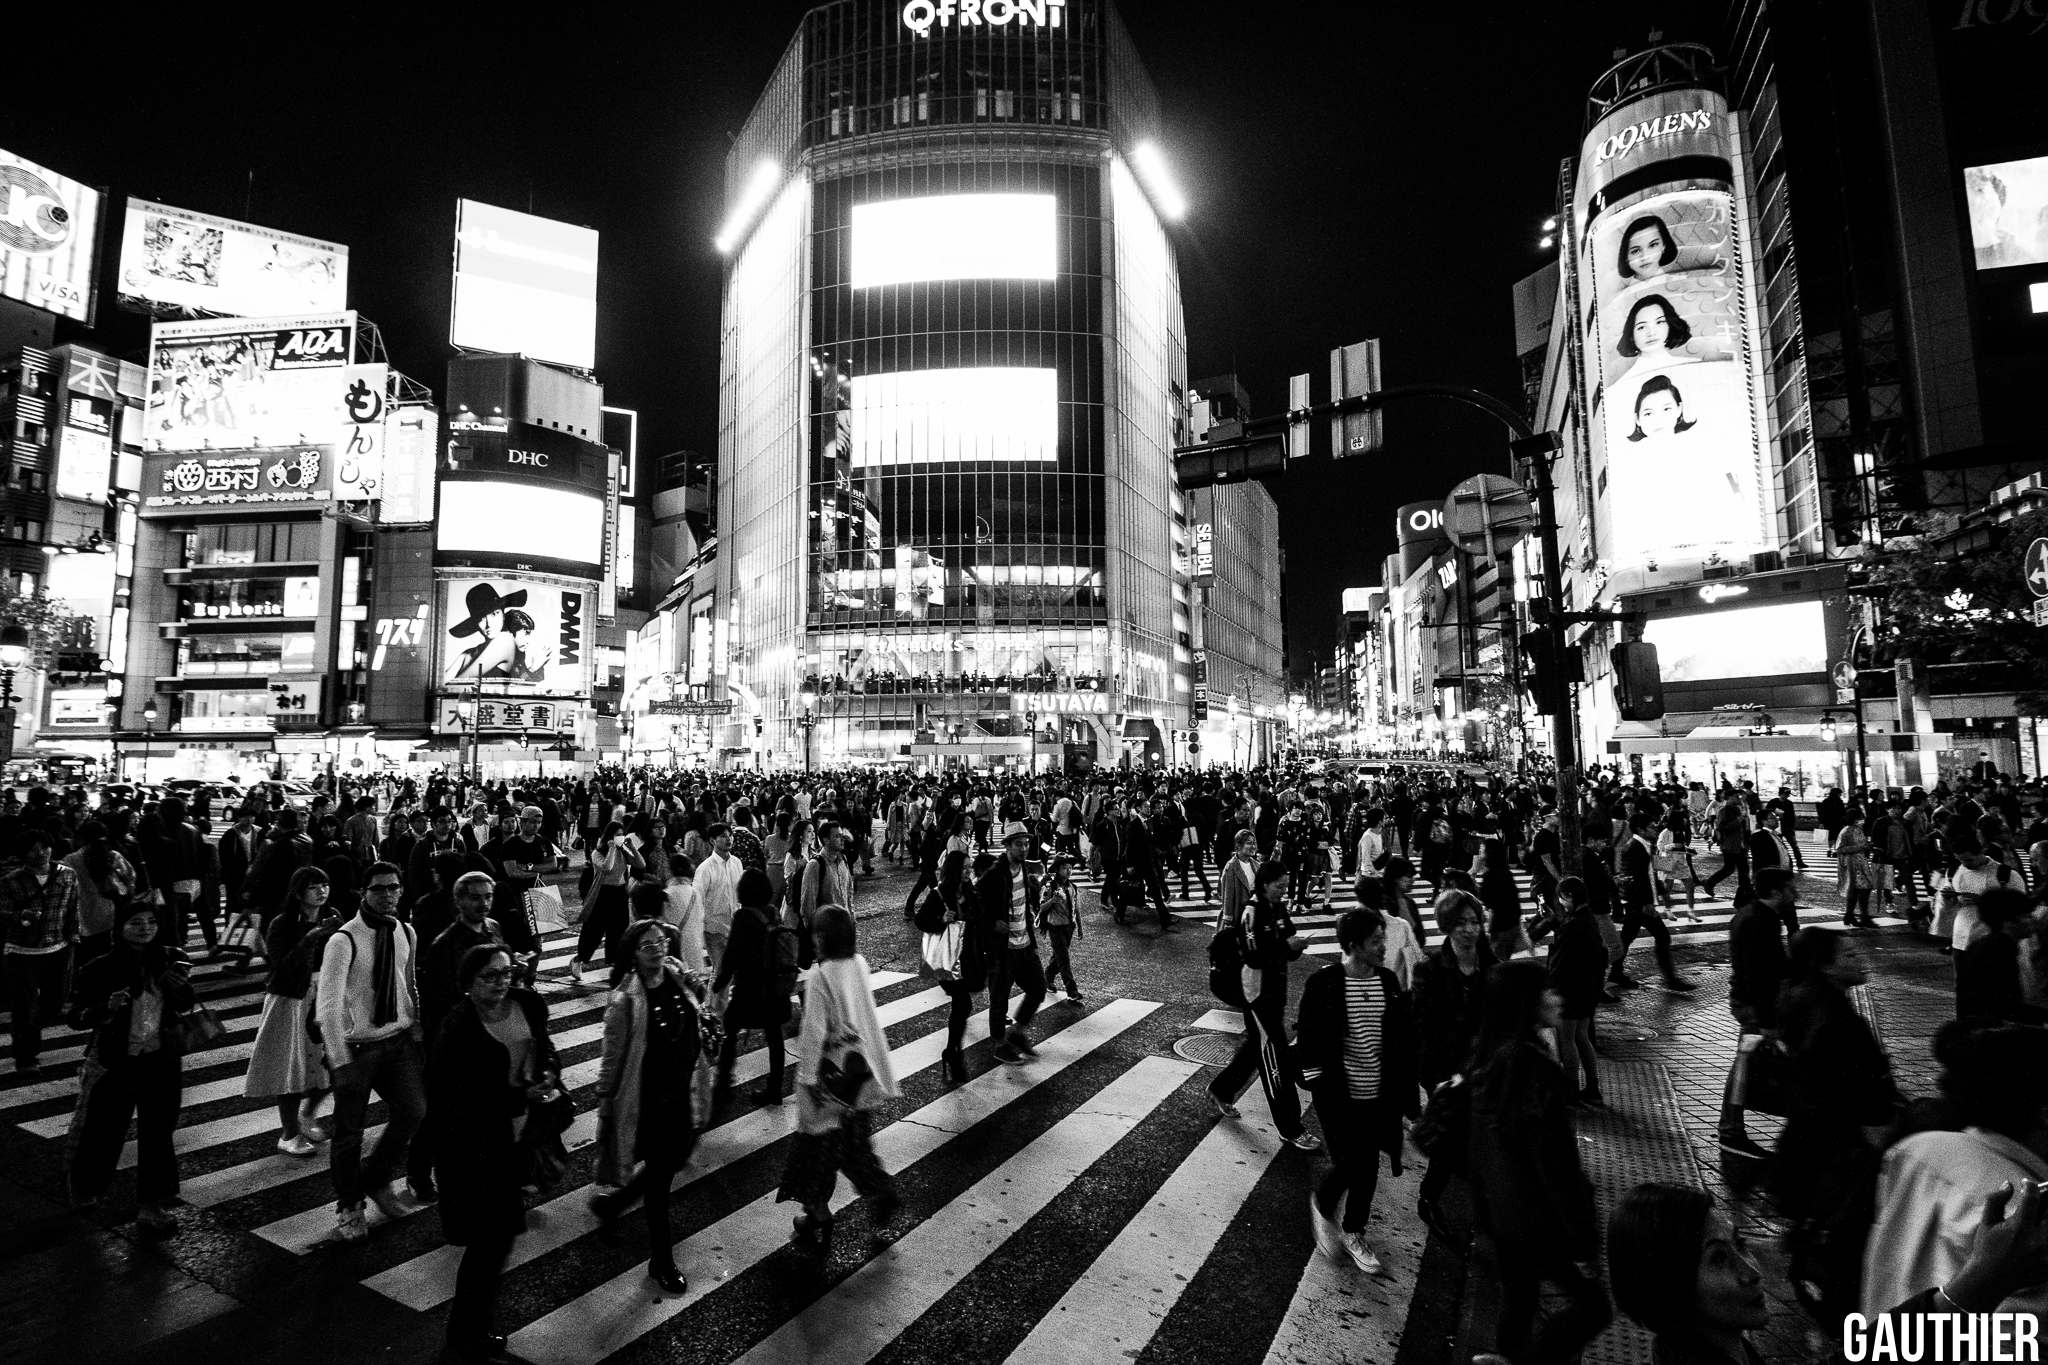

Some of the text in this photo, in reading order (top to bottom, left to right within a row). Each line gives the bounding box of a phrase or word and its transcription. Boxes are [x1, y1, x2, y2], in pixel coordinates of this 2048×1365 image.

[903, 0, 1065, 37] QFRONT
[39, 281, 81, 304] VISA
[278, 329, 346, 356] AOA
[508, 449, 549, 468] DHC
[205, 467, 261, 491] 西村
[559, 591, 582, 666] DMM
[1013, 693, 1108, 713] TSUTAYA
